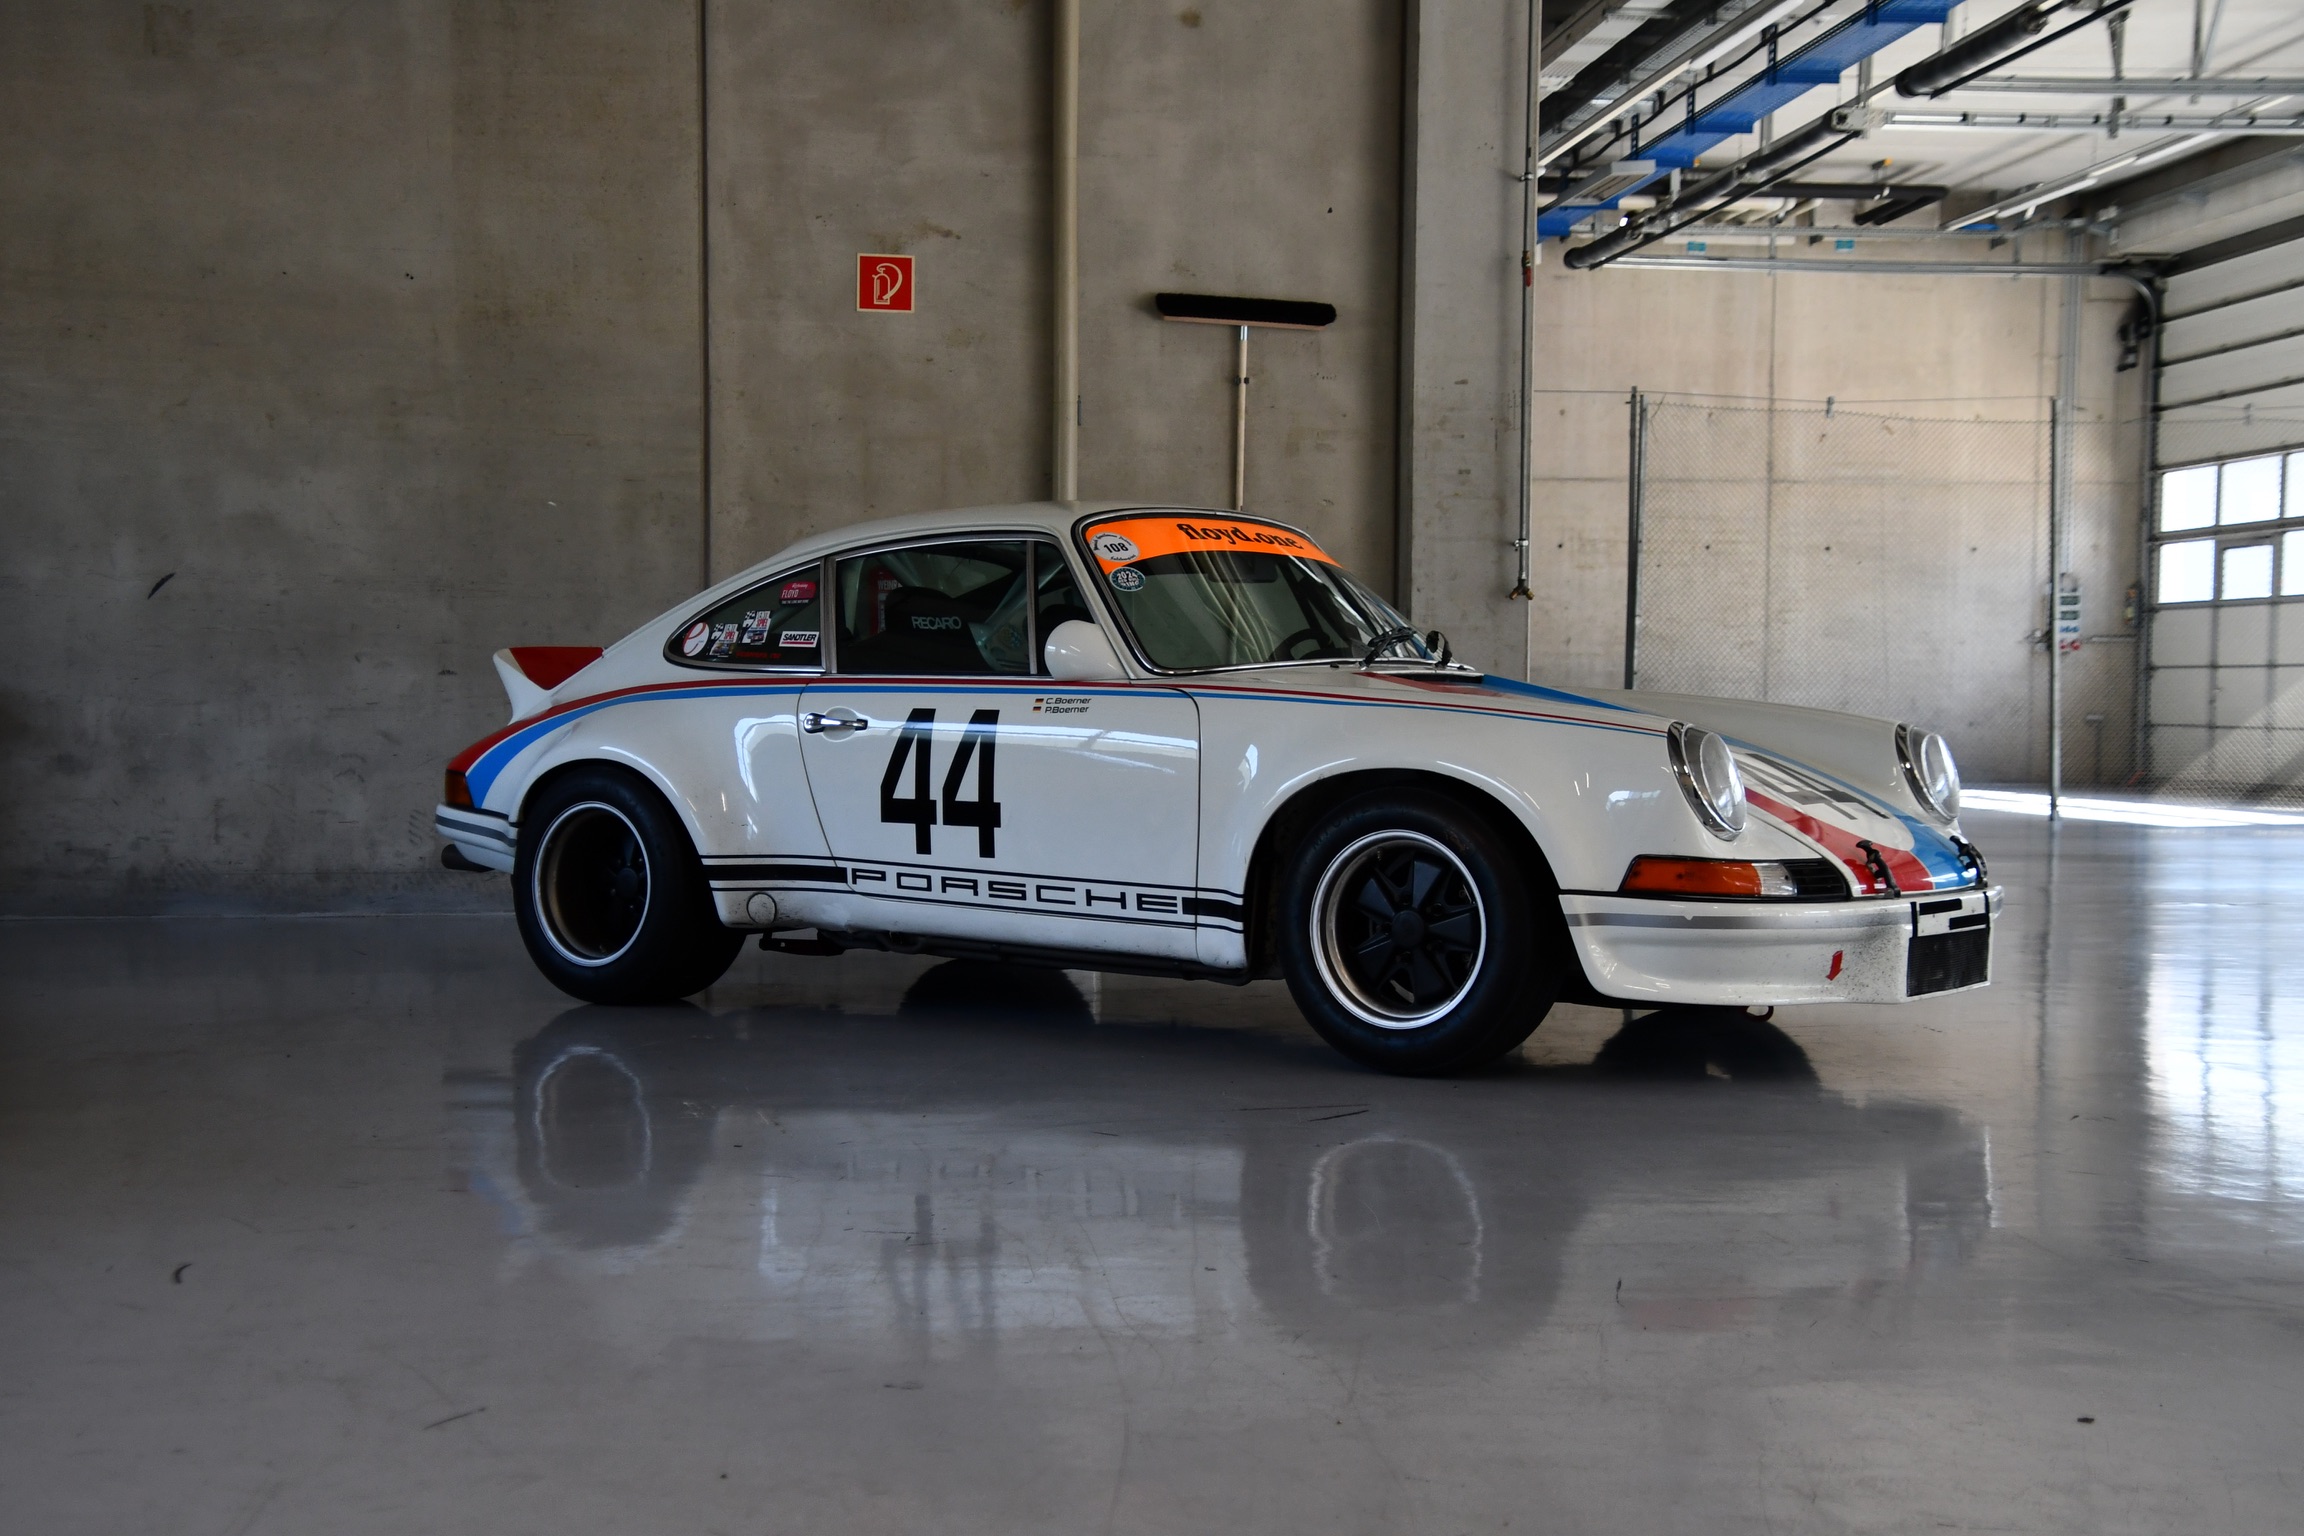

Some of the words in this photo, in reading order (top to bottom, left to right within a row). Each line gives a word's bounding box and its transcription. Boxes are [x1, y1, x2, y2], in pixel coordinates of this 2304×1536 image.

[1176, 523, 1304, 549] floyd.one
[1104, 542, 1129, 553] 108
[781, 589, 799, 598] FLOYD
[911, 616, 962, 630] RECARO
[782, 633, 817, 642] SANDTLER
[1045, 706, 1089, 714] P.Boerner
[880, 708, 1002, 859] 44
[851, 867, 1178, 914] PORSCHE
